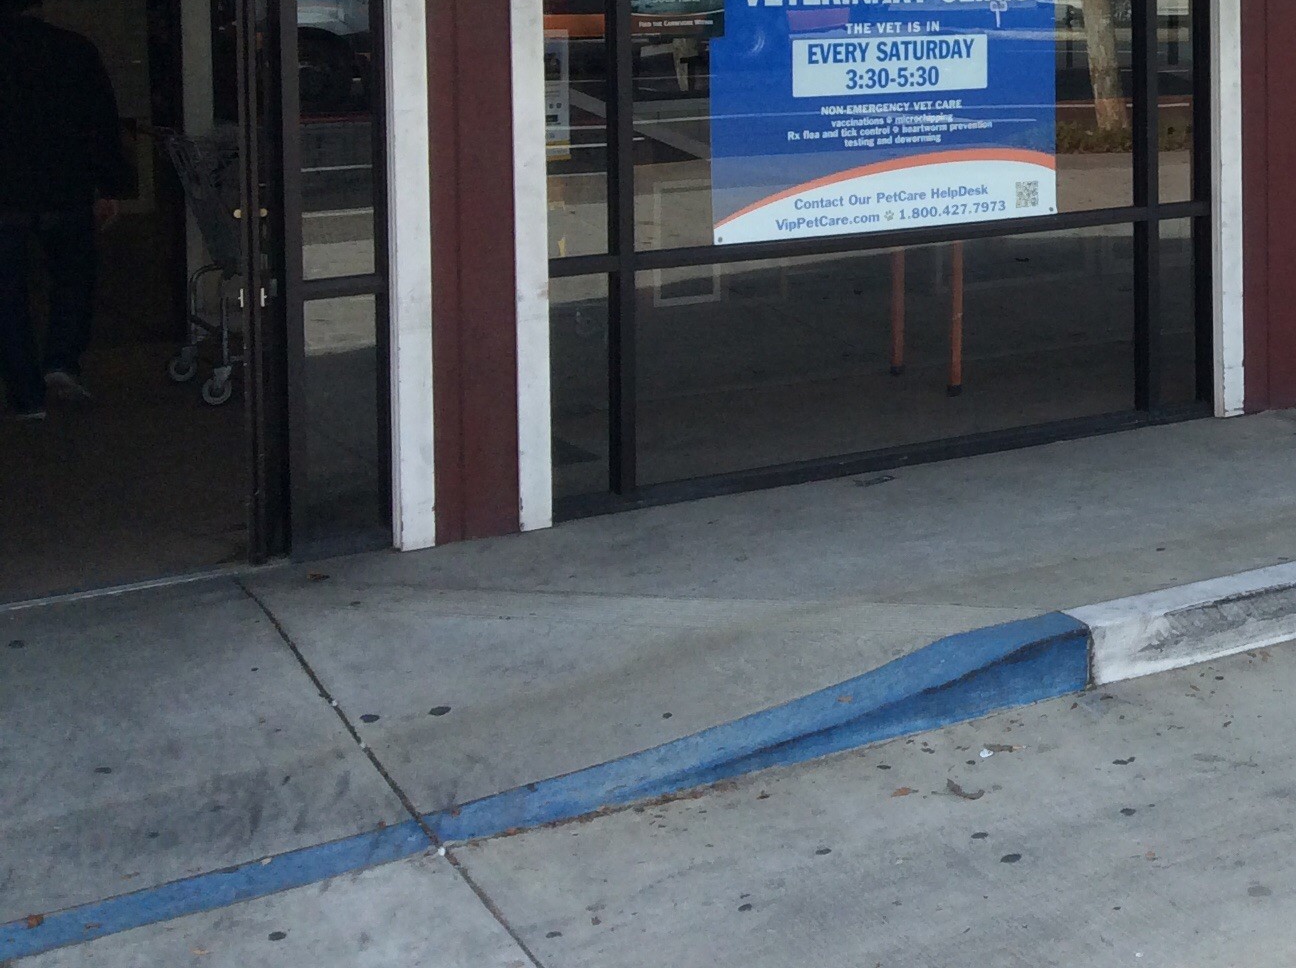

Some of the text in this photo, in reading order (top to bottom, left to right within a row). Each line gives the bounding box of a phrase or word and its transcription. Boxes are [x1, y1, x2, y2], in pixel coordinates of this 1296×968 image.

[845, 21, 939, 34] THE VET IS IN
[807, 38, 974, 64] EVERY SATURDAY
[845, 66, 939, 90] 3:30-5:30
[821, 99, 962, 115] NON-EMERGENCY VET CARE
[787, 120, 993, 141] Rx flea and tick control heartworm prevention
[831, 117, 884, 128] vaccinations
[844, 133, 941, 148] testing and deworming
[794, 184, 988, 211] Contact Our PetCare HelpDesk
[775, 200, 1007, 232] VipPetCare.com 1.800.427.7973
